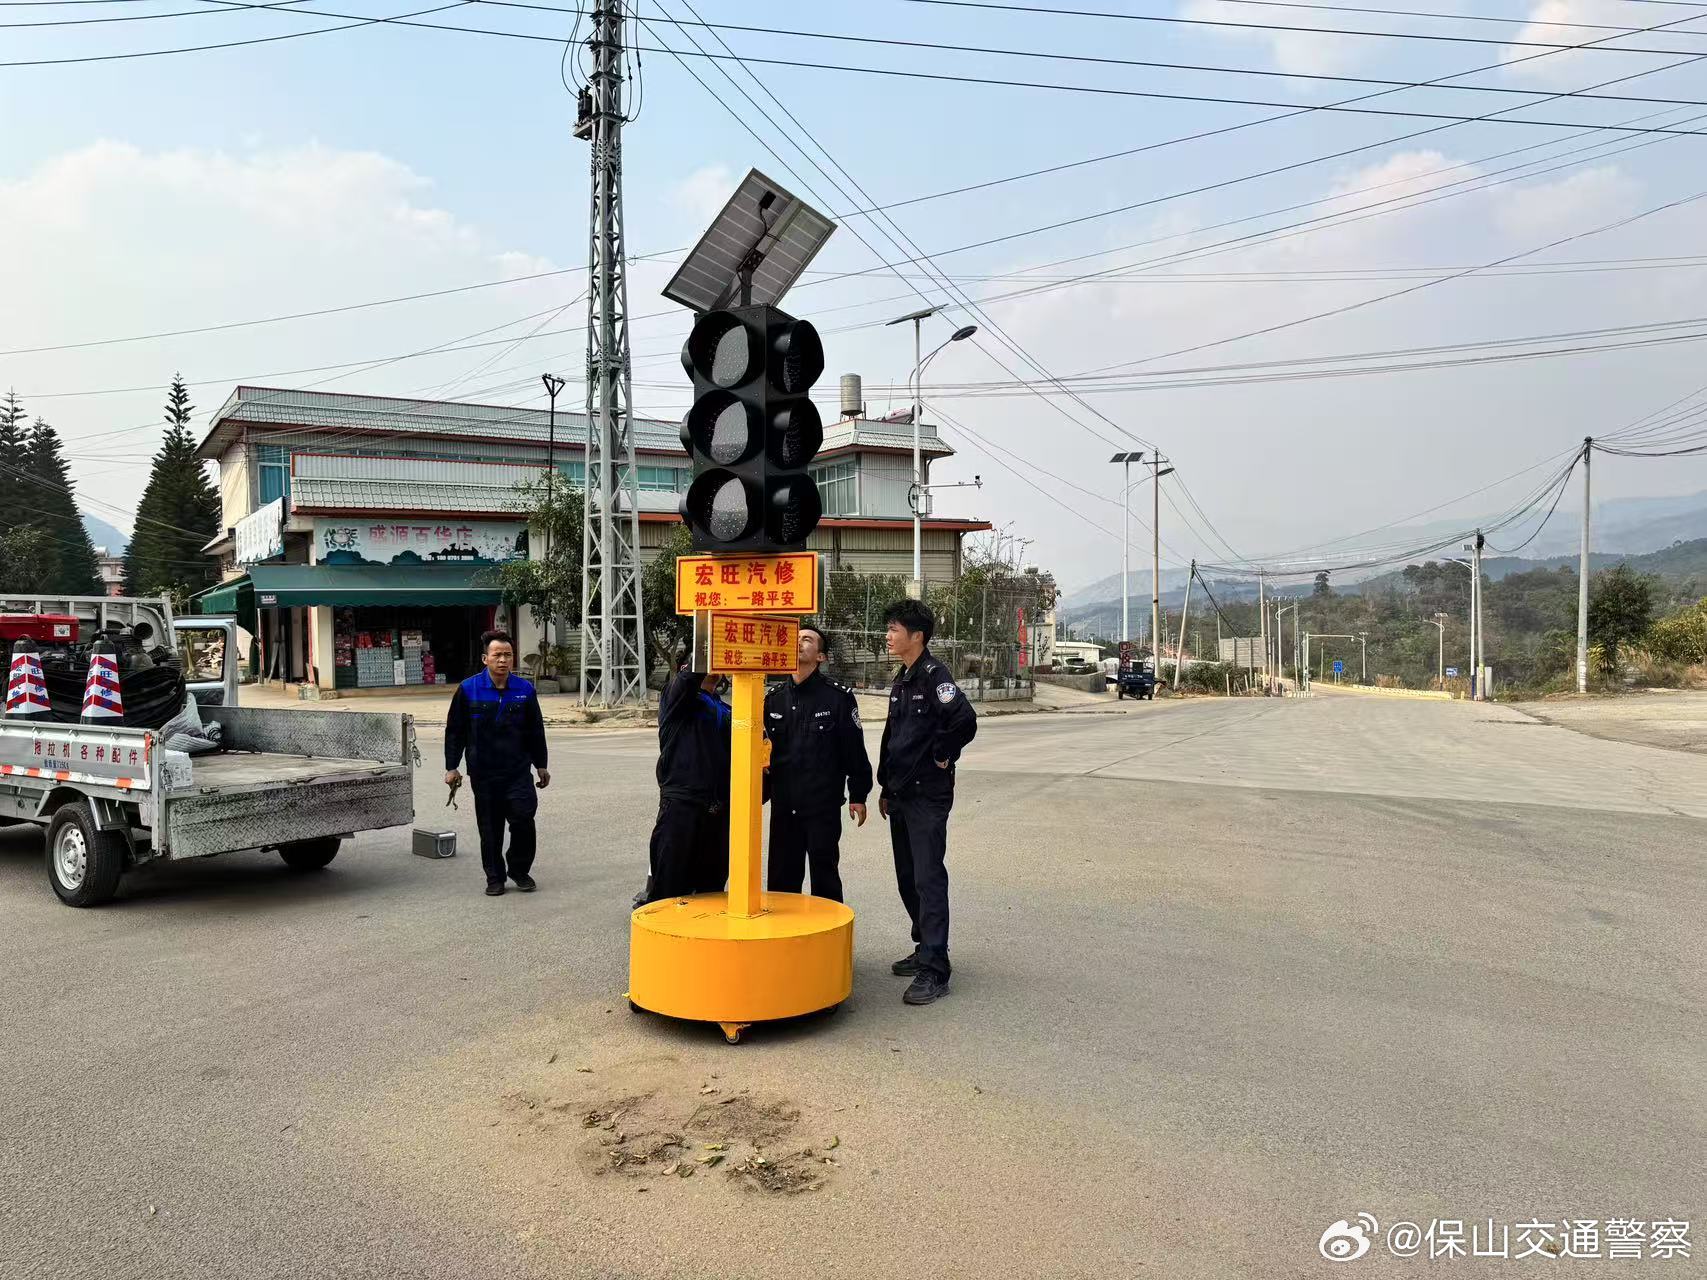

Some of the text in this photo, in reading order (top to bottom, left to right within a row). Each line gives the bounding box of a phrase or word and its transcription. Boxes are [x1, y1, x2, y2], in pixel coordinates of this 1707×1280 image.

[369, 525, 473, 548] 盛源百货店
[695, 560, 795, 586] 宏旺汽修
[725, 620, 789, 647] 宏旺汽修
[34, 741, 138, 766] 拖拉机各种配件
